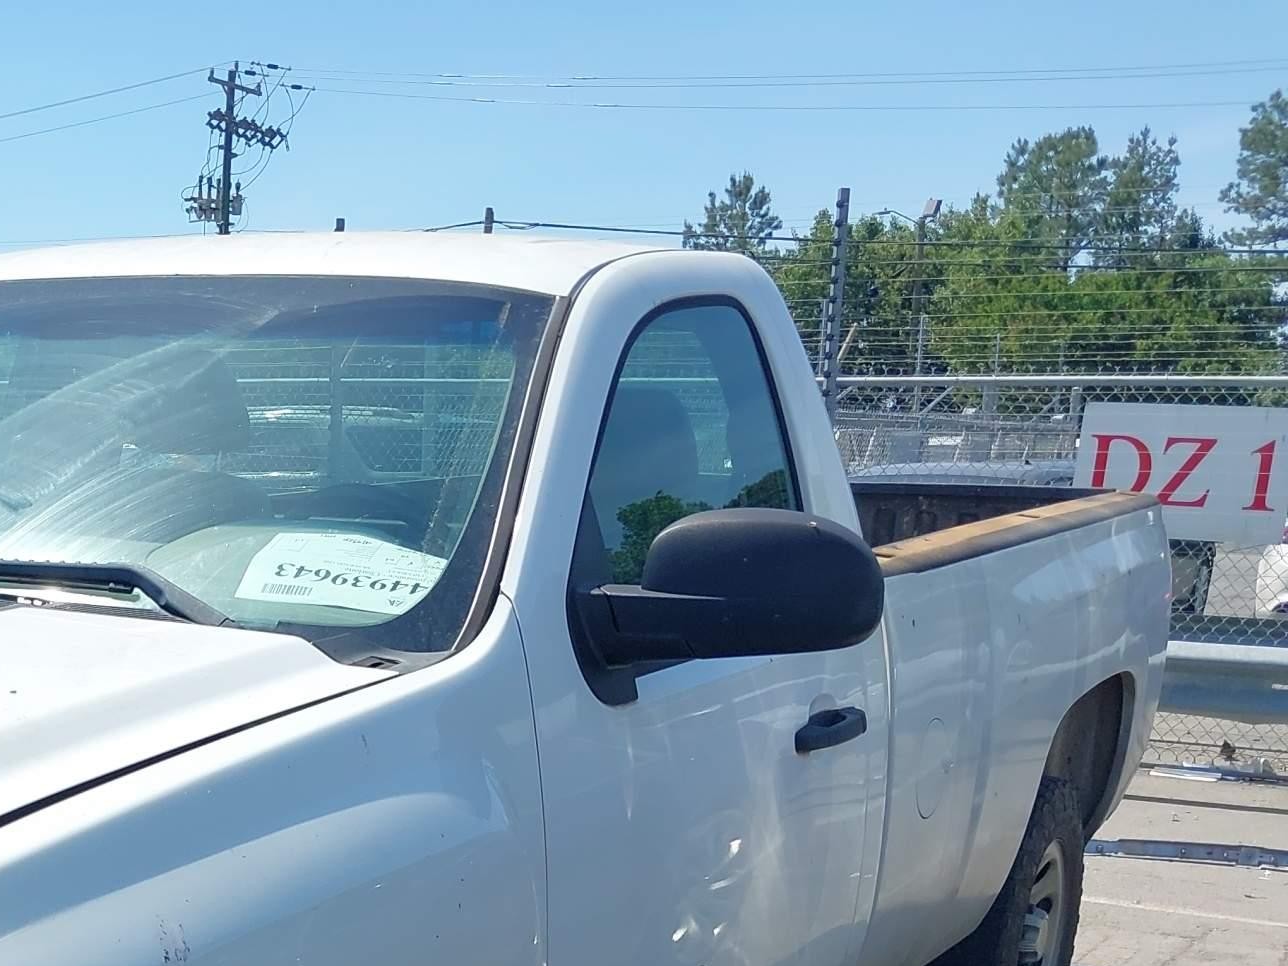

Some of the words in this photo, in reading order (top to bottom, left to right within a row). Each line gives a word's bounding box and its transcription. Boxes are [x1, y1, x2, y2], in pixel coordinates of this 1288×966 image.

[1092, 435, 1218, 507] DZ
[1242, 439, 1276, 511] 1
[275, 562, 430, 595] 44939643
